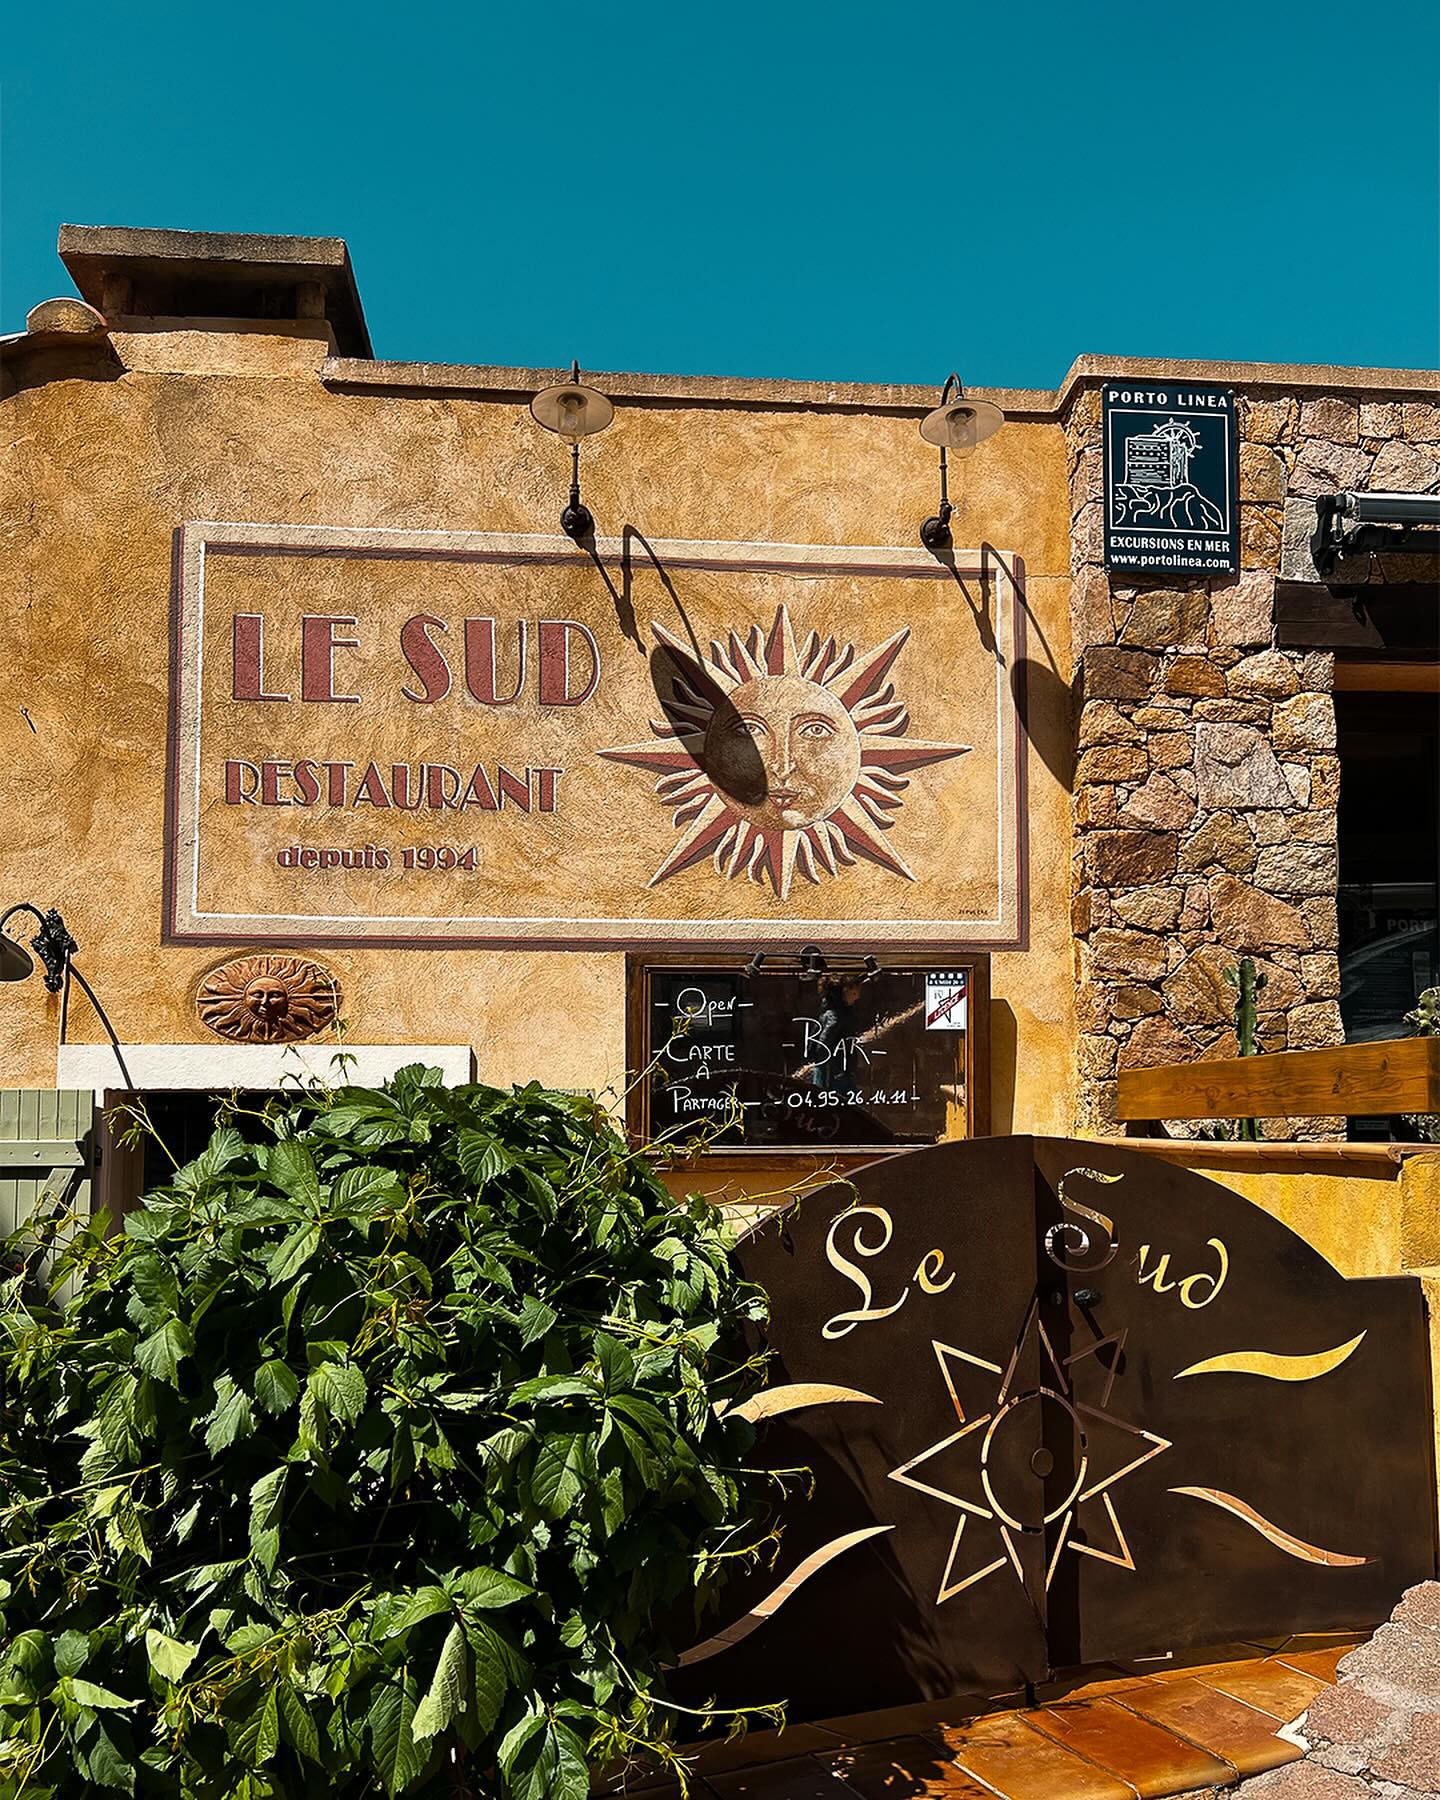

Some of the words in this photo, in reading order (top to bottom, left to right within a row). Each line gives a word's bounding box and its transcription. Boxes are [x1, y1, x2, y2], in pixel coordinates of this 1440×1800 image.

[1109, 391, 1168, 405] PORTO
[1178, 394, 1228, 408] LINEA
[1110, 536, 1184, 550] EXCURSIONS
[1187, 539, 1201, 552] EN
[1205, 541, 1230, 553] MER
[1111, 554, 1230, 568] www.portolinea.com
[232, 613, 362, 704] LE
[400, 614, 601, 706] SUD
[225, 760, 564, 813] RESTAURANT
[276, 843, 390, 870] depuis
[401, 847, 479, 871] 1994
[695, 1061, 710, 1080] À
[821, 1205, 956, 1339] Le
[1044, 1167, 1229, 1309] Sud
